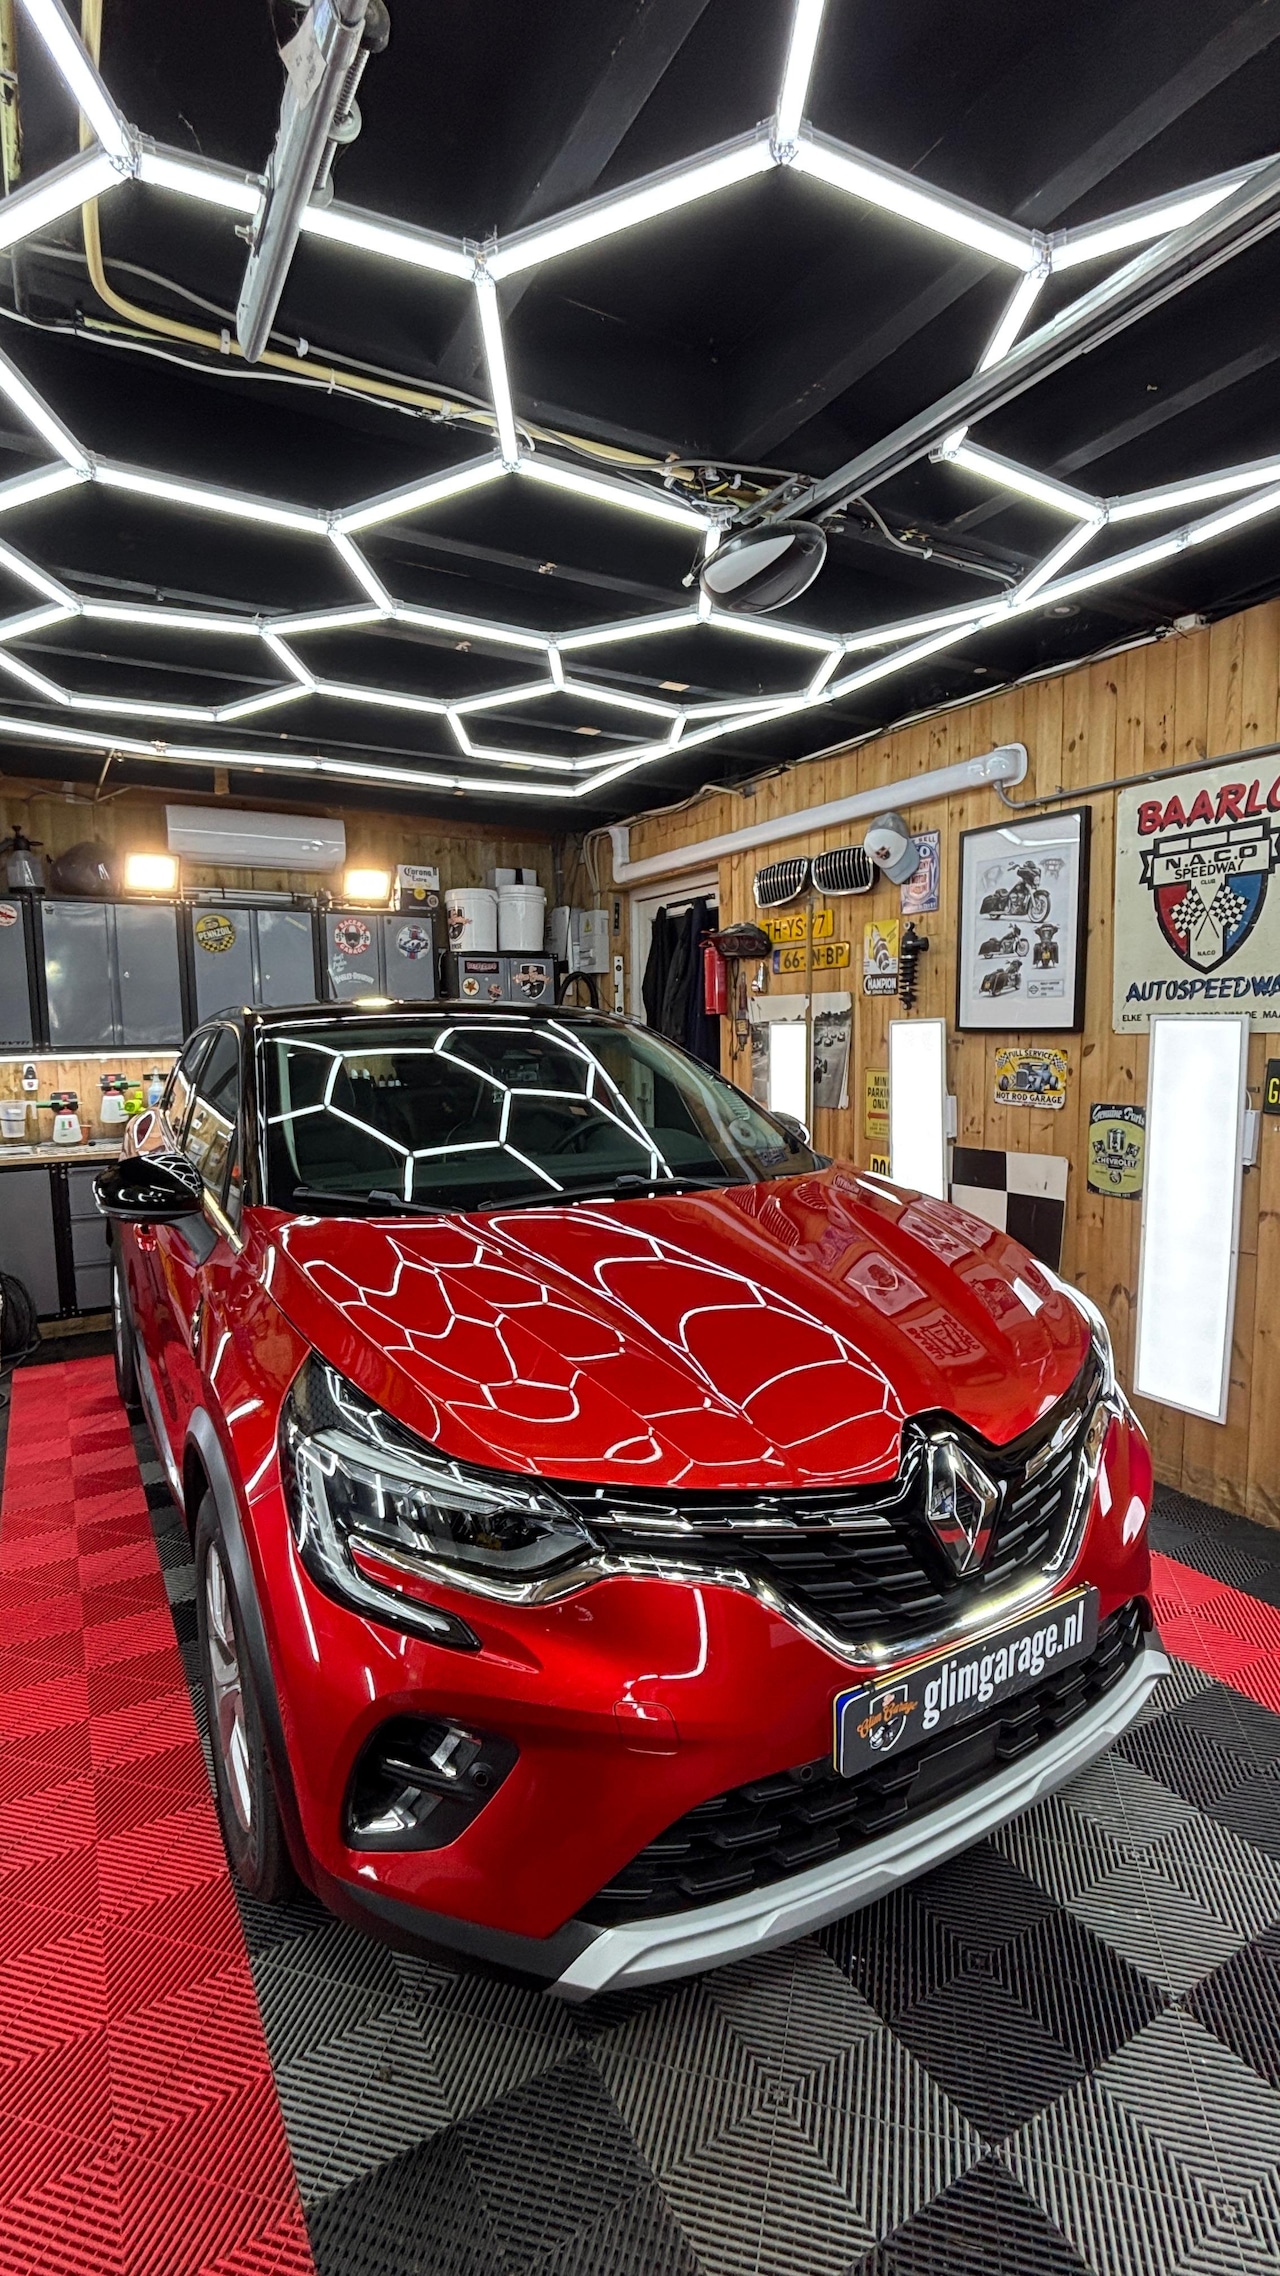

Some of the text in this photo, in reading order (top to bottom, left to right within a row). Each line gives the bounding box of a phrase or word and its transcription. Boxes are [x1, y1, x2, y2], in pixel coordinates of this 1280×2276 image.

[403, 867, 432, 877] Corona
[1174, 859, 1244, 880] SPEEDWAY
[198, 926, 233, 941] PENNZOIL
[340, 944, 367, 954] GARAGE
[784, 946, 844, 969] 66-N-BP
[863, 974, 897, 995] CHAMPION
[1125, 974, 1280, 1003] AUTOSPEEDWA
[1122, 1014, 1142, 1022] ELKE
[1262, 1010, 1280, 1019] MA
[1008, 1049, 1053, 1060] FULL SERVICE
[873, 1076, 888, 1087] MIN
[996, 1091, 1010, 1099] HOT
[1029, 1094, 1062, 1104] GARAGE
[1268, 1077, 1280, 1104] G
[1092, 1105, 1145, 1126] Genuine Parts
[1096, 1156, 1136, 1168] CHEVROLET
[922, 1600, 1085, 1730] glimgarage.nl
